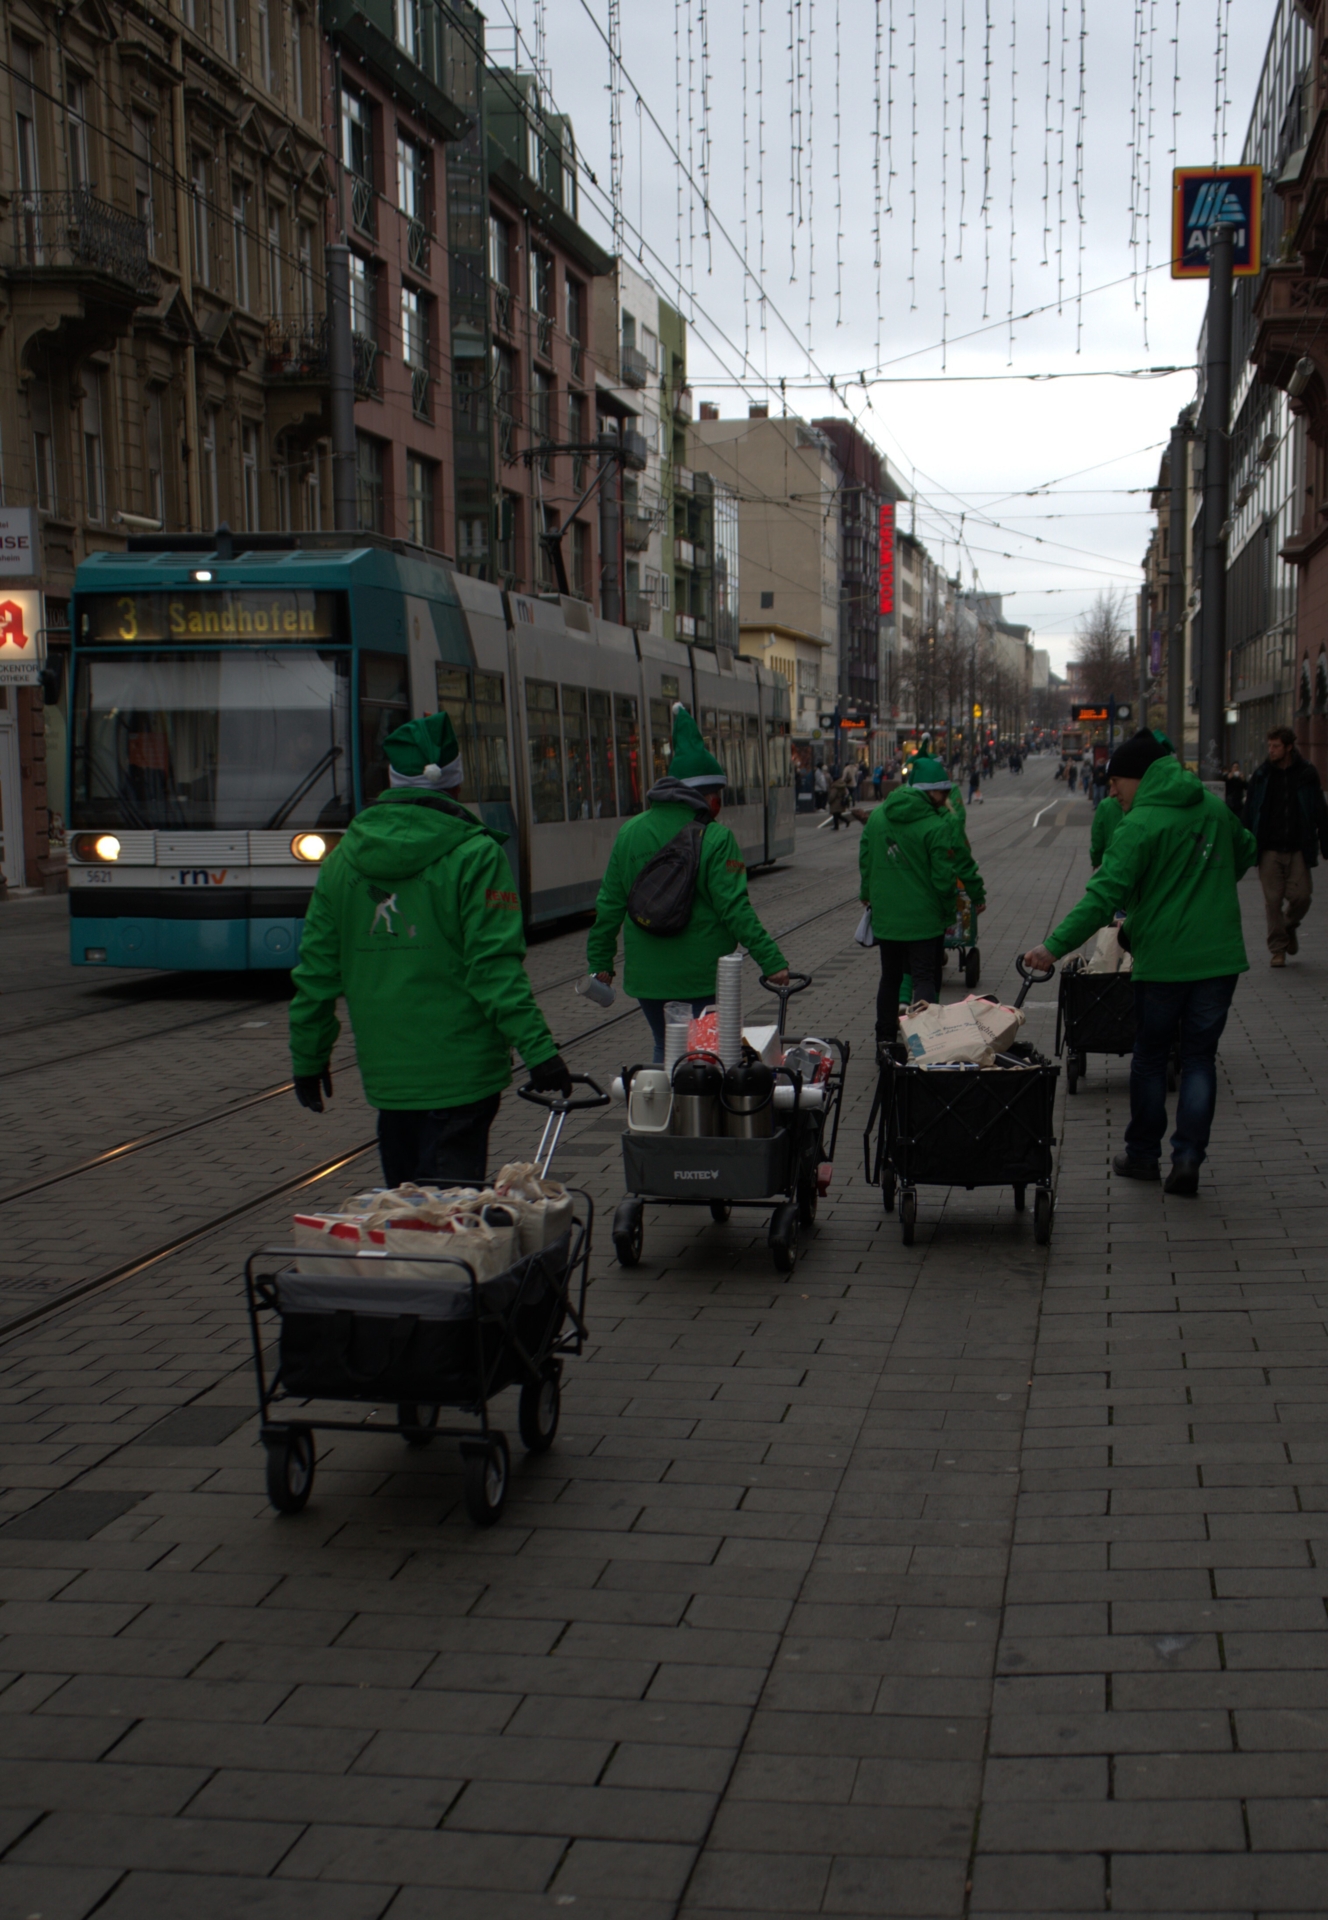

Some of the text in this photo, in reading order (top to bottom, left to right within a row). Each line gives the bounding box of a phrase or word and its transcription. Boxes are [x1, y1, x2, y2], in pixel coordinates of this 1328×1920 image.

[879, 504, 893, 615] WOOLWORTH
[117, 597, 315, 640] 3 Sandhofen
[87, 869, 227, 884] 5621 rnv
[485, 888, 518, 904] REWE
[674, 1171, 711, 1180] FUXTEC
